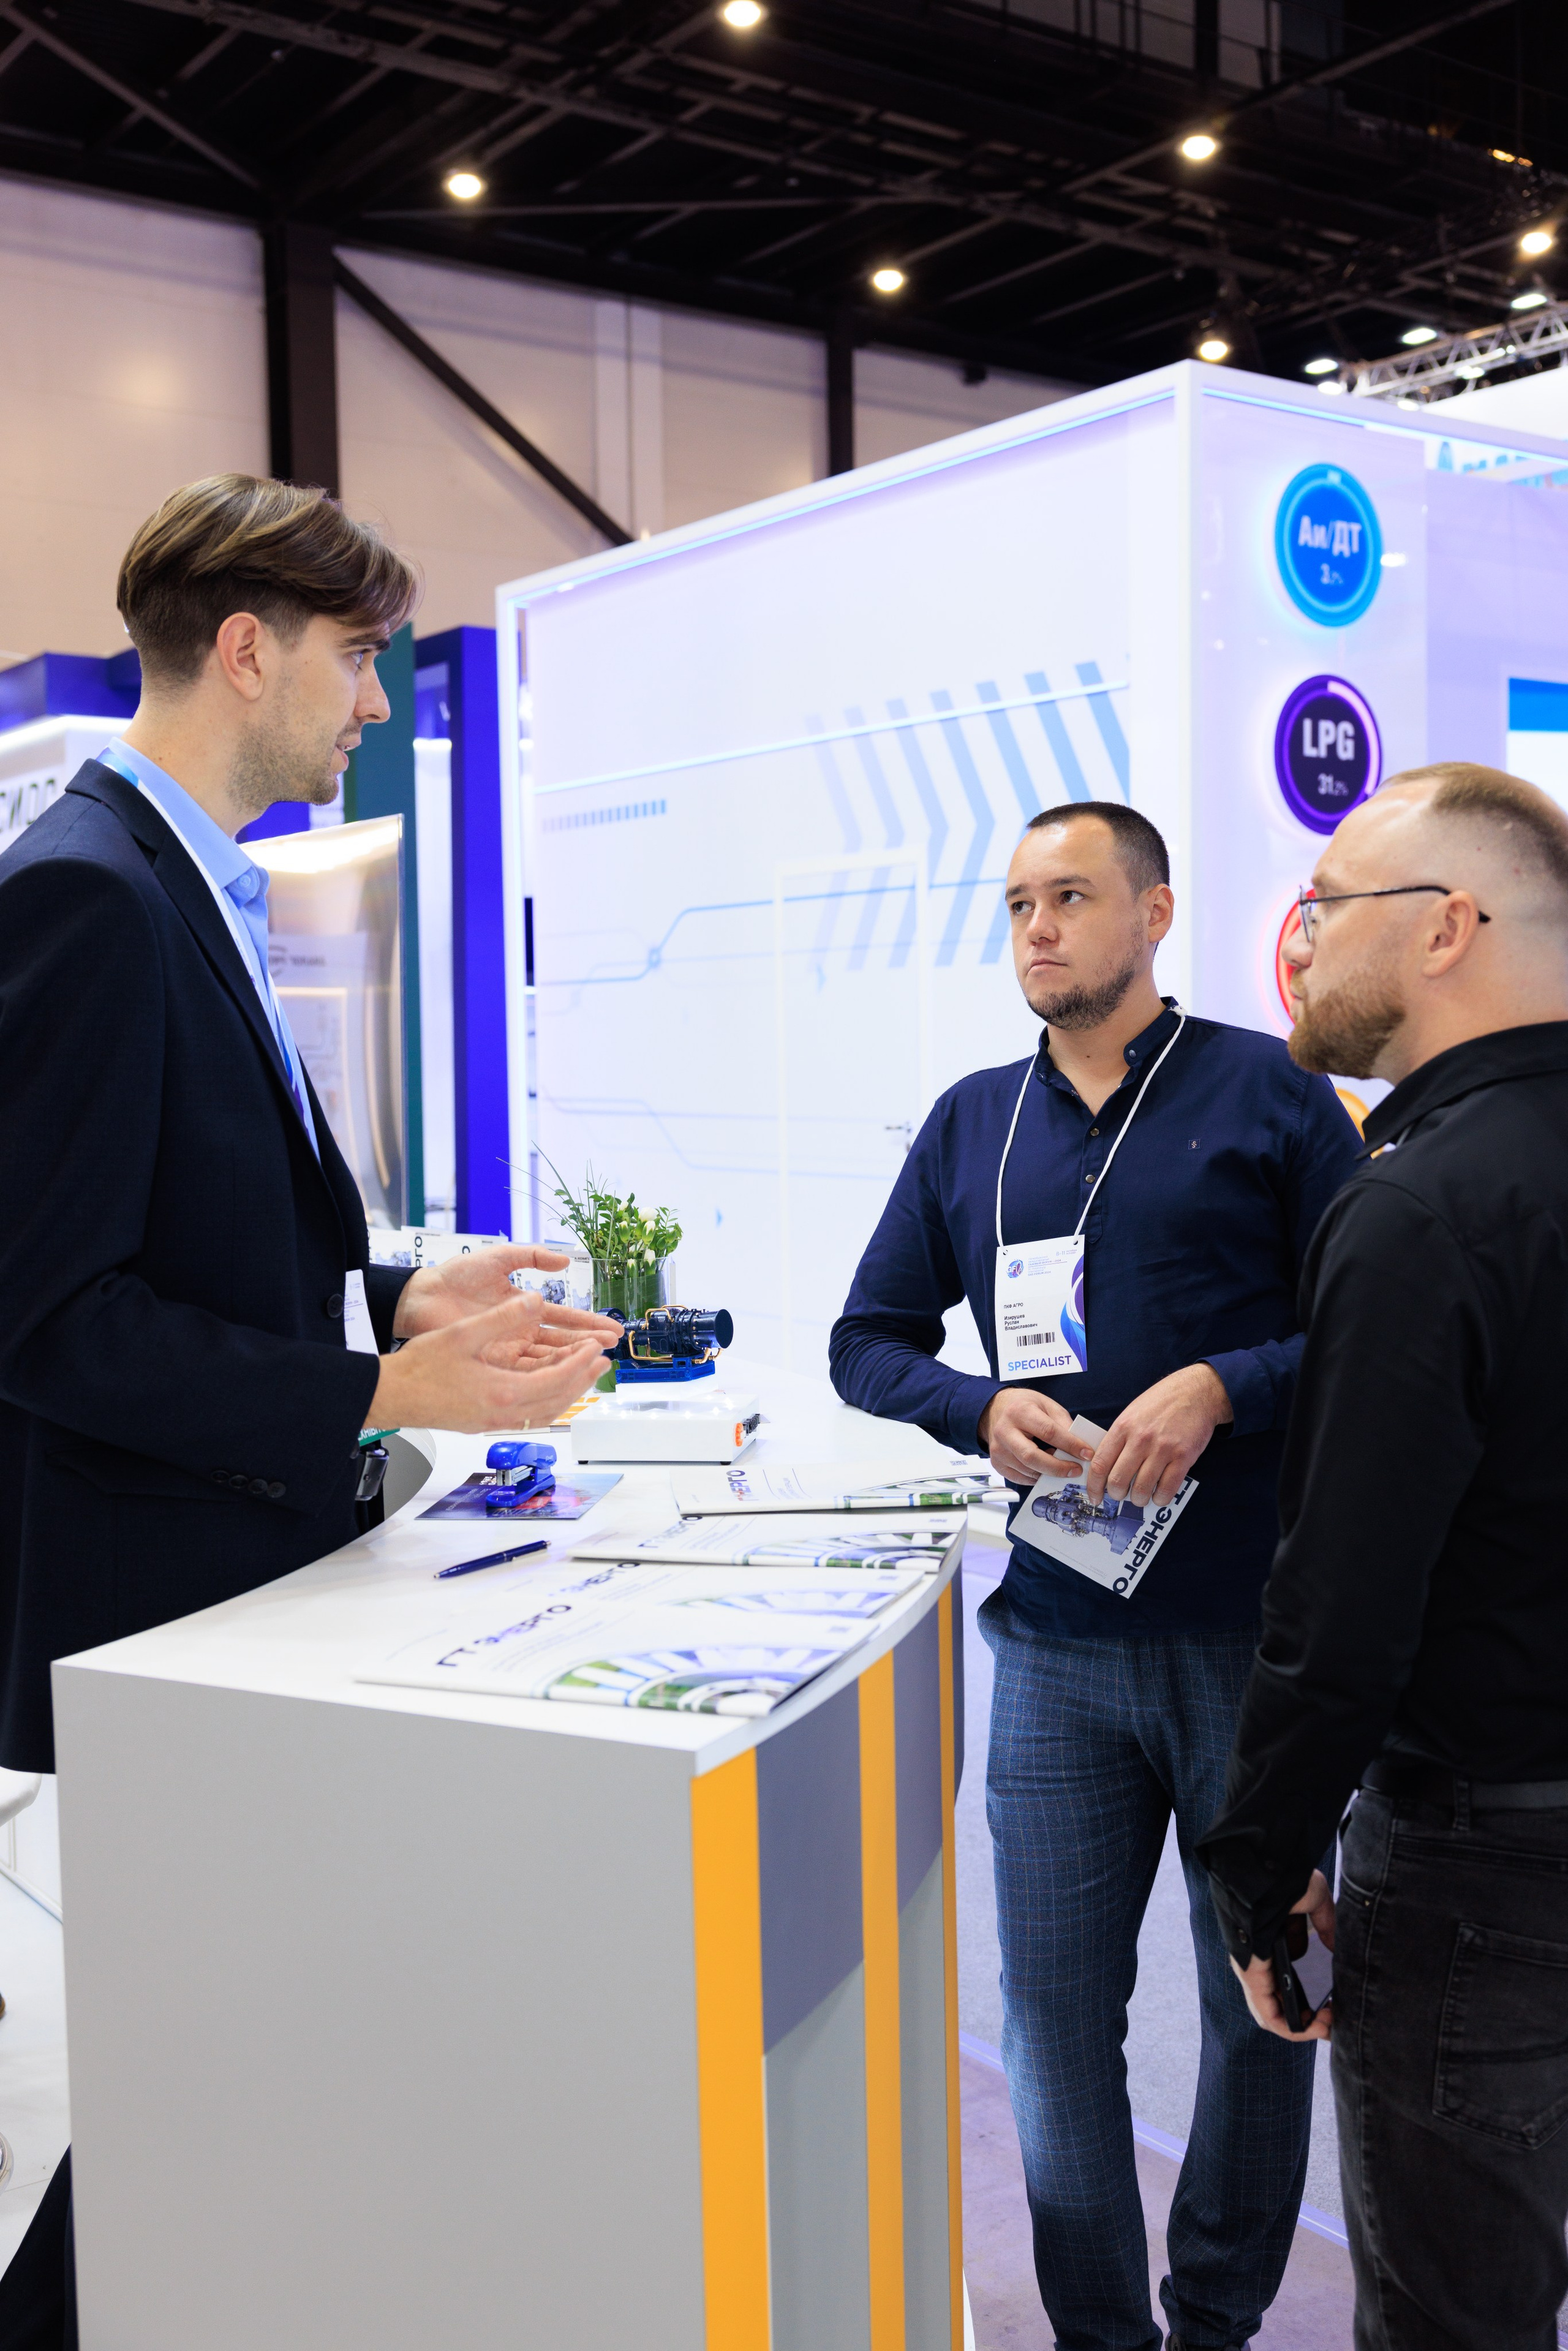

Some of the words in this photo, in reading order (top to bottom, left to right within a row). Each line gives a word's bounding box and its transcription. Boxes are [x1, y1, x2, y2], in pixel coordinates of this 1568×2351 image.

[1302, 718, 1355, 760] LPG
[1008, 1355, 1071, 1371] SPECIALIST
[1113, 1506, 1172, 1594] ЭНЕРГО
